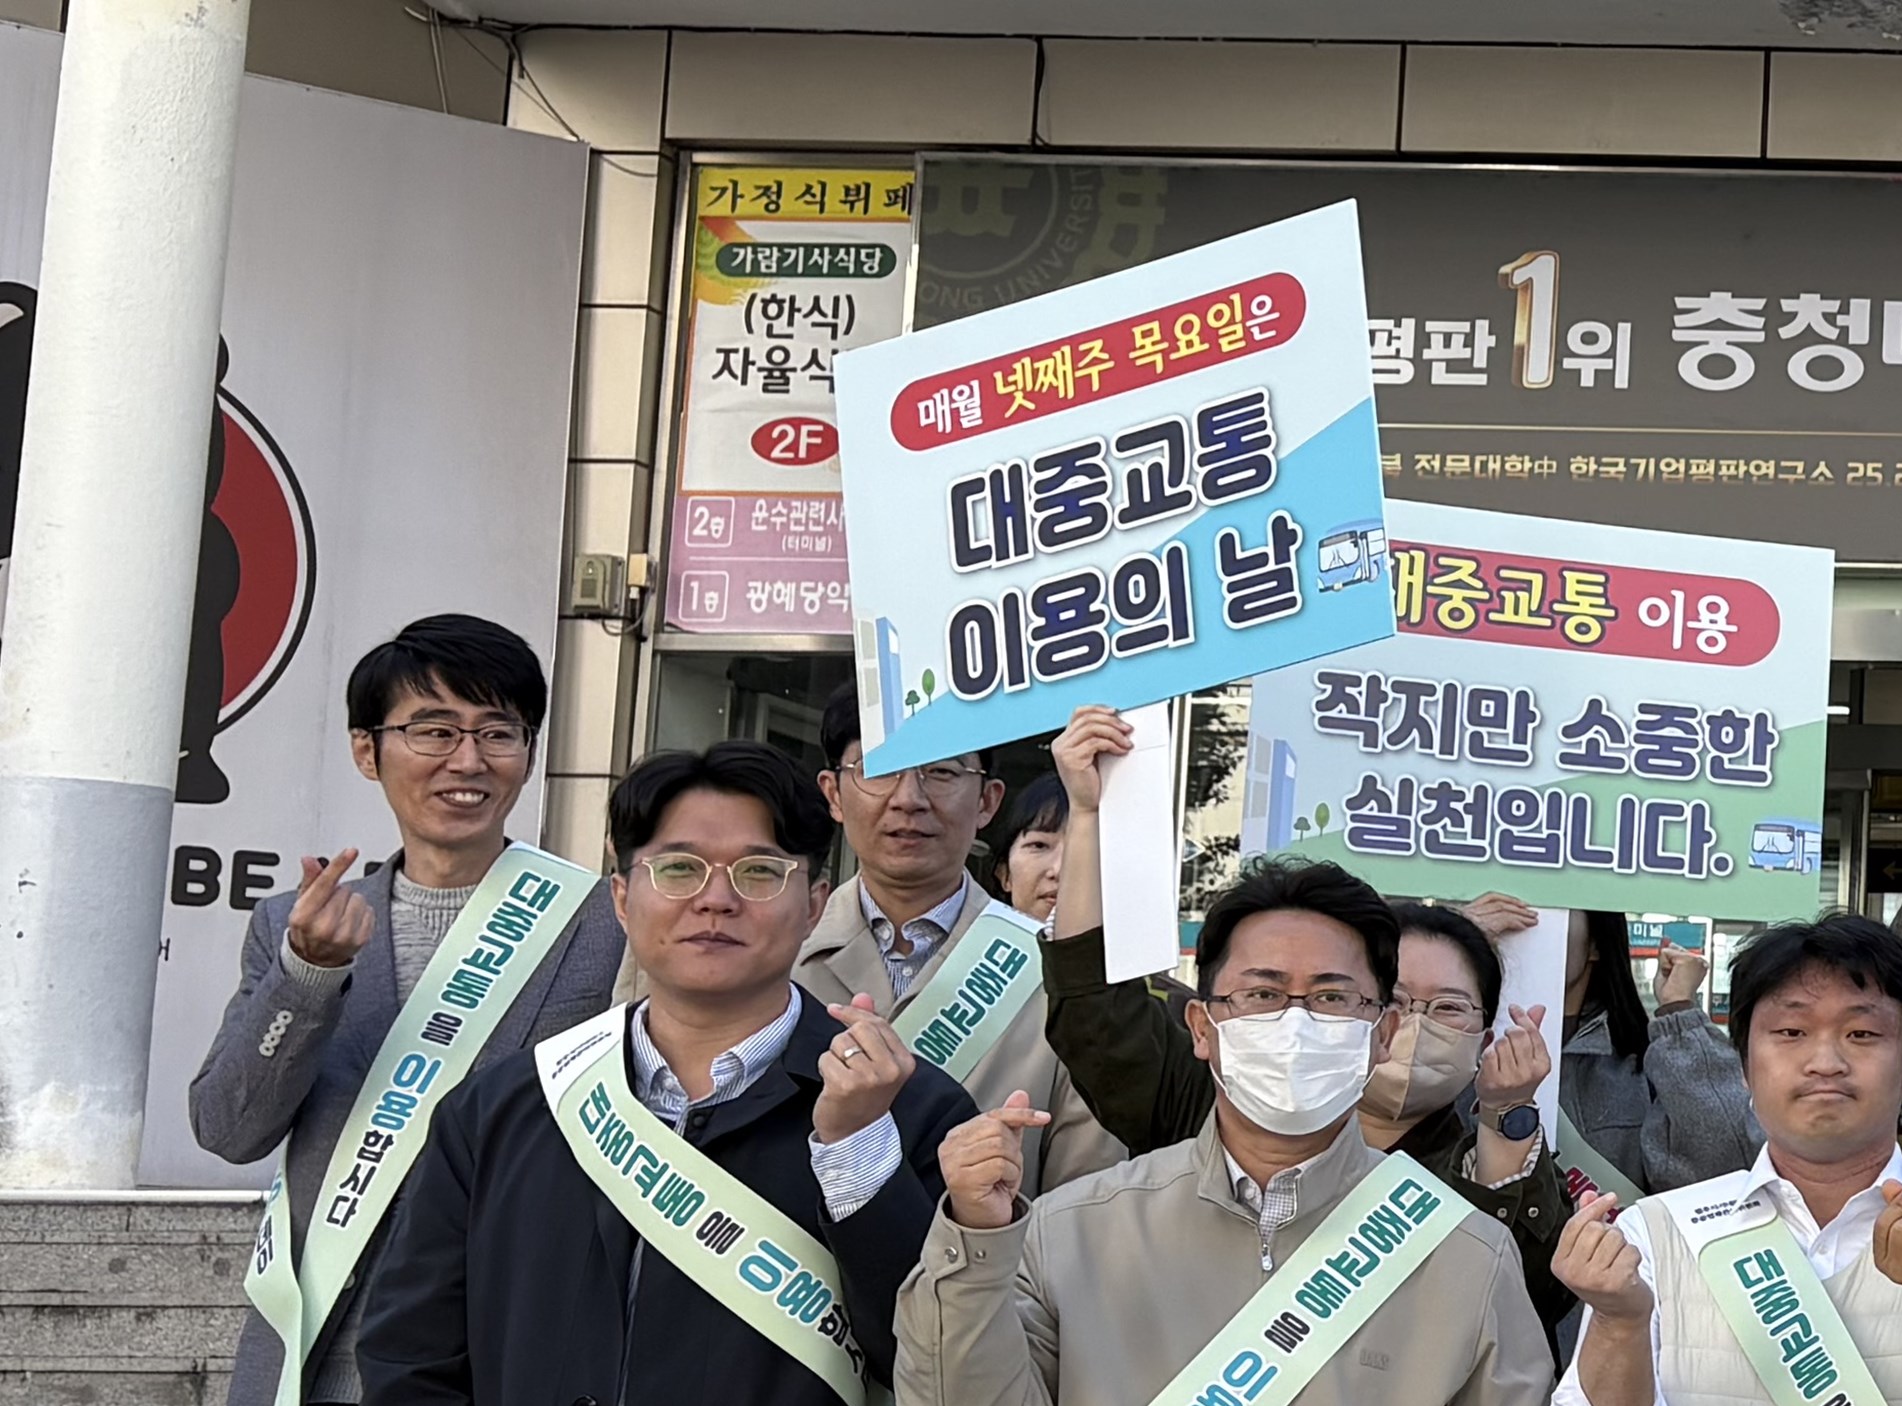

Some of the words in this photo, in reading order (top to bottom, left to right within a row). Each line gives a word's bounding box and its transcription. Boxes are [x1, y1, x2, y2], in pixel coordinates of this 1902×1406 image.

[731, 247, 883, 274] 가람기사식당
[744, 293, 855, 340] (한식)
[917, 381, 982, 434] 매월
[992, 339, 1115, 420] 넷째주
[1128, 290, 1281, 376] 목요일은
[770, 425, 823, 458] 2F
[948, 387, 1276, 571] 대중교통
[948, 543, 1193, 699] 이용의
[1218, 510, 1302, 629] 날
[1638, 596, 1737, 655] 이용
[1312, 668, 1541, 770] 작지만
[1558, 694, 1778, 789] 소중한
[1341, 772, 1735, 879] 실천입니다.
[913, 937, 1029, 1066] 대중교통
[325, 1052, 442, 1230] 이용합시다
